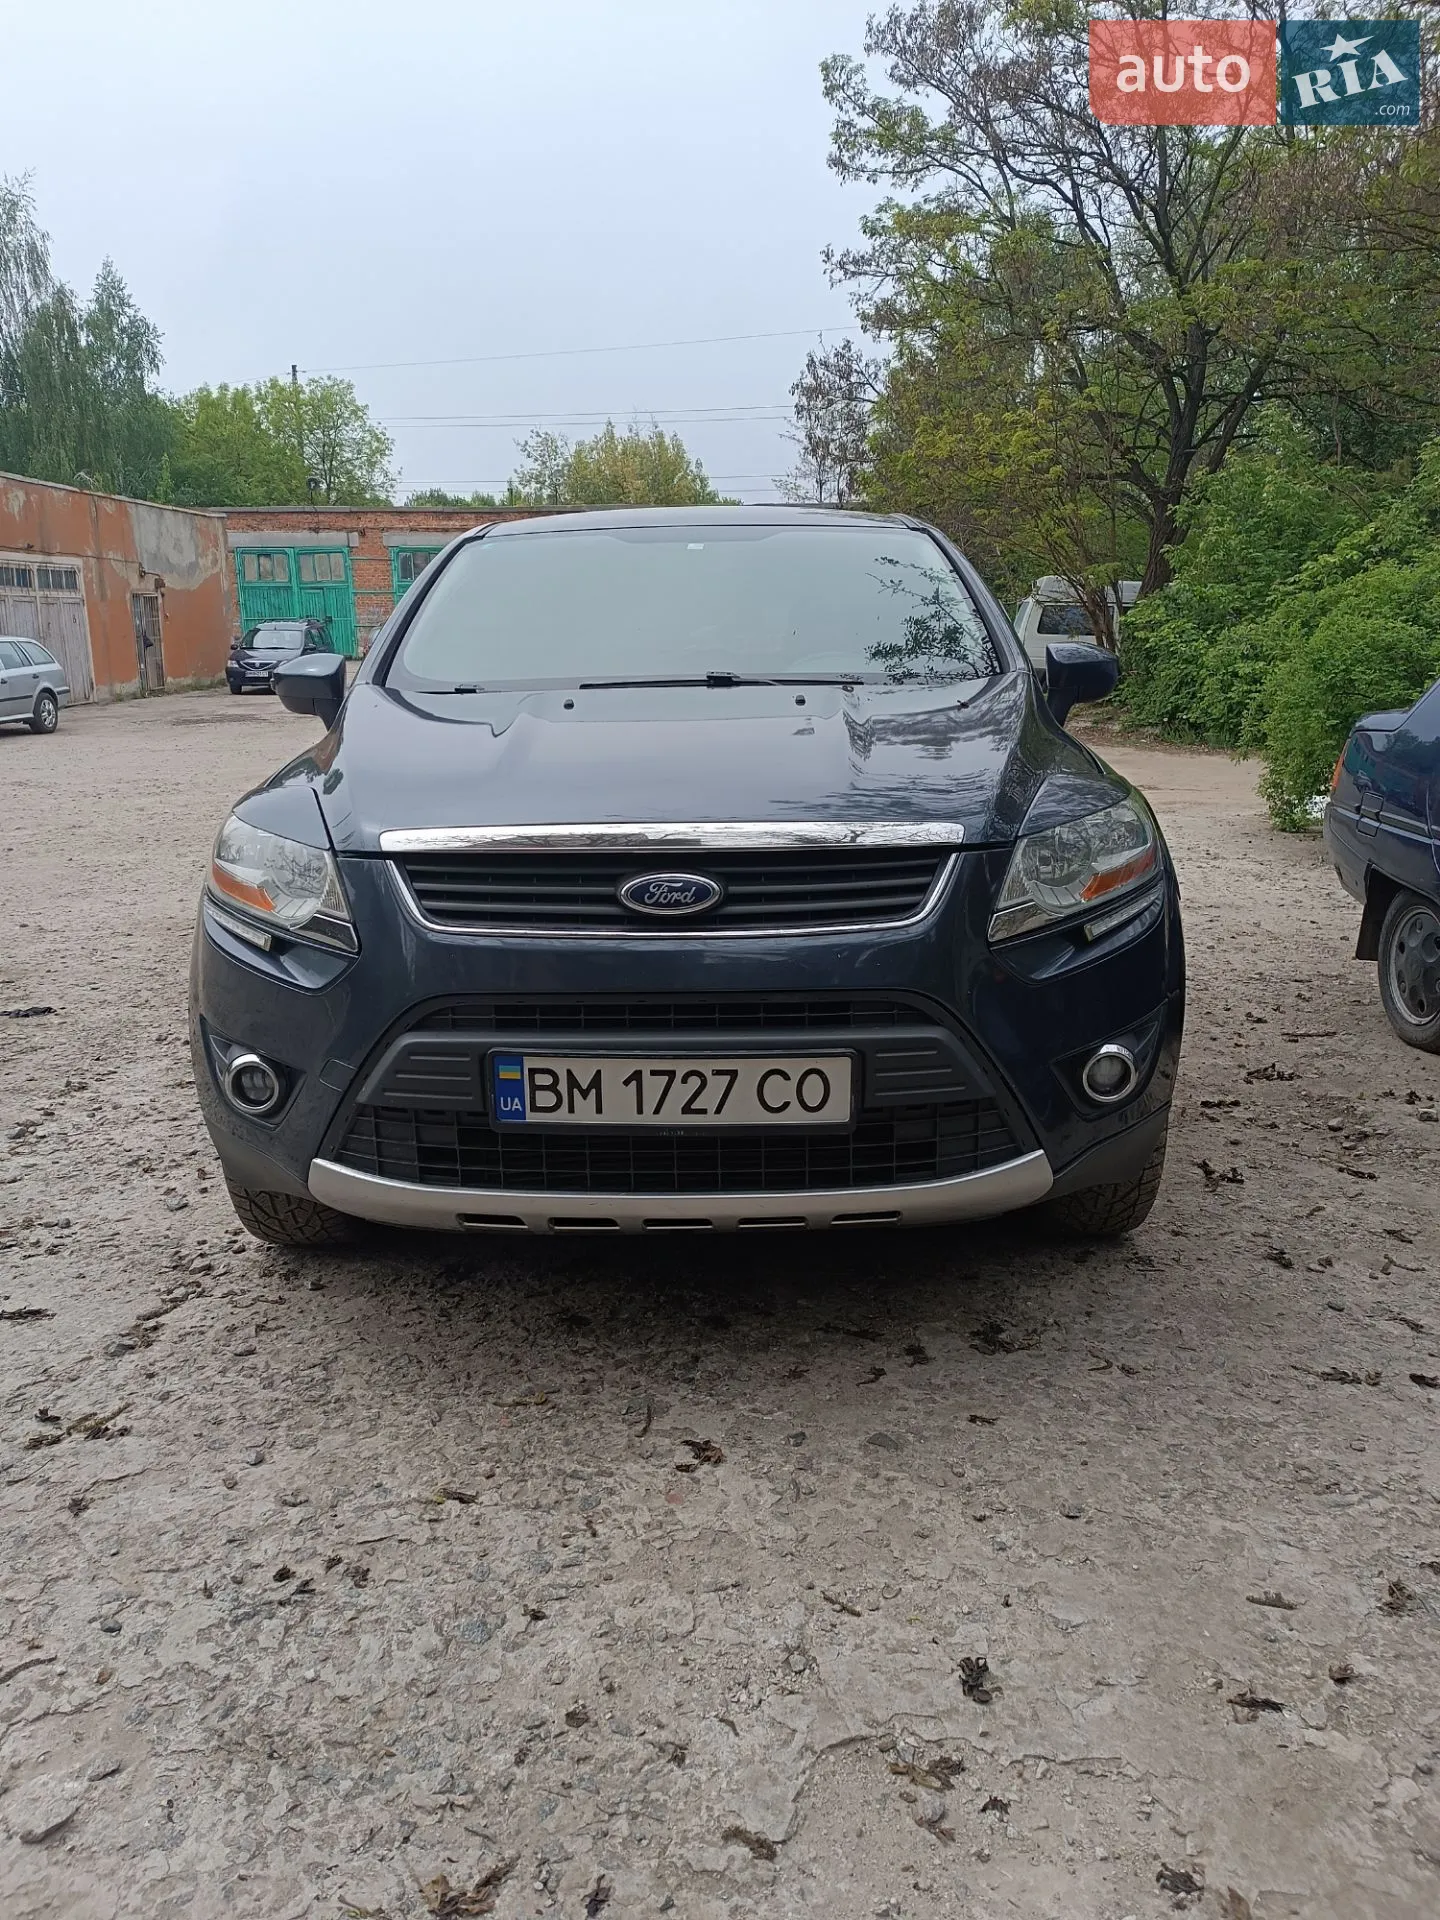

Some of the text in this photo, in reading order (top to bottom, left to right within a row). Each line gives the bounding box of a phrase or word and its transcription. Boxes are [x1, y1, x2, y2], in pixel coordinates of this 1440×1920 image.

[644, 881, 697, 904] Ford
[526, 1067, 831, 1116] BM 1727 CO
[500, 1097, 523, 1112] UA
